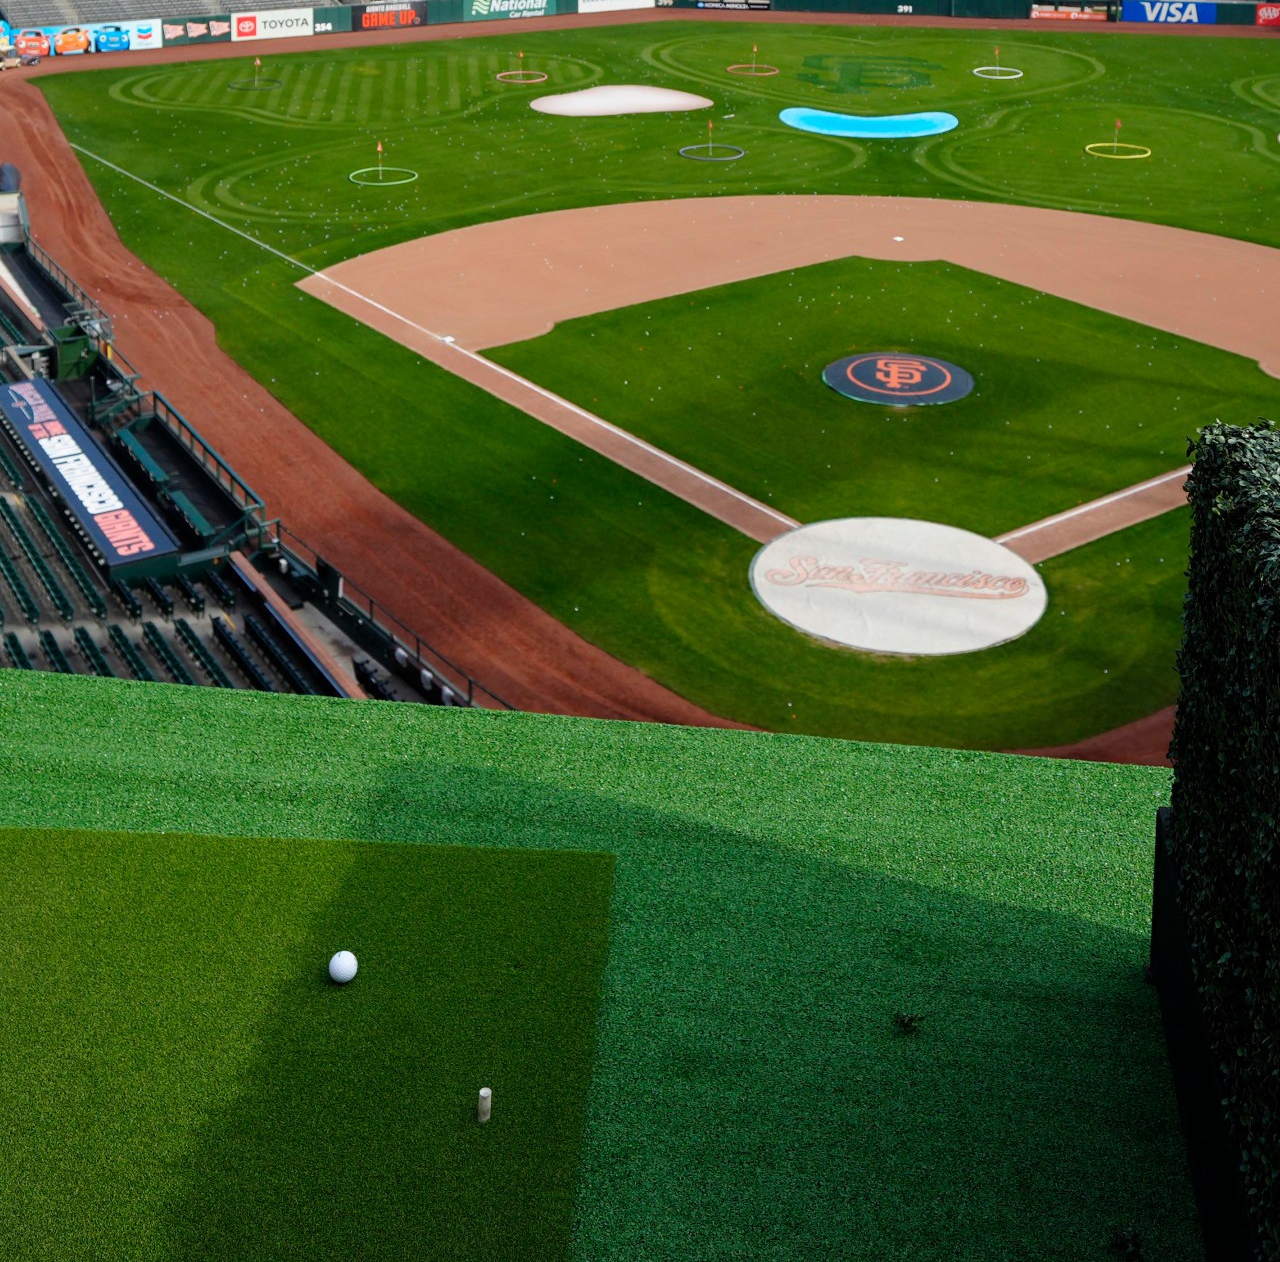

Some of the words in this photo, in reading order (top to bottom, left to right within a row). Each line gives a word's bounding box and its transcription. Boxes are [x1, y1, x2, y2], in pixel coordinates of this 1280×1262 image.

[521, 9, 545, 17] Rental
[897, 4, 913, 13] 391
[1140, 2, 1199, 23] VISA
[261, 18, 309, 30] TOYOTA
[362, 11, 396, 28] GAME
[400, 9, 416, 25] UP
[314, 22, 332, 32] 354
[93, 508, 155, 556] GIANTS
[765, 555, 853, 586] San
[854, 558, 1030, 591] Francisco
